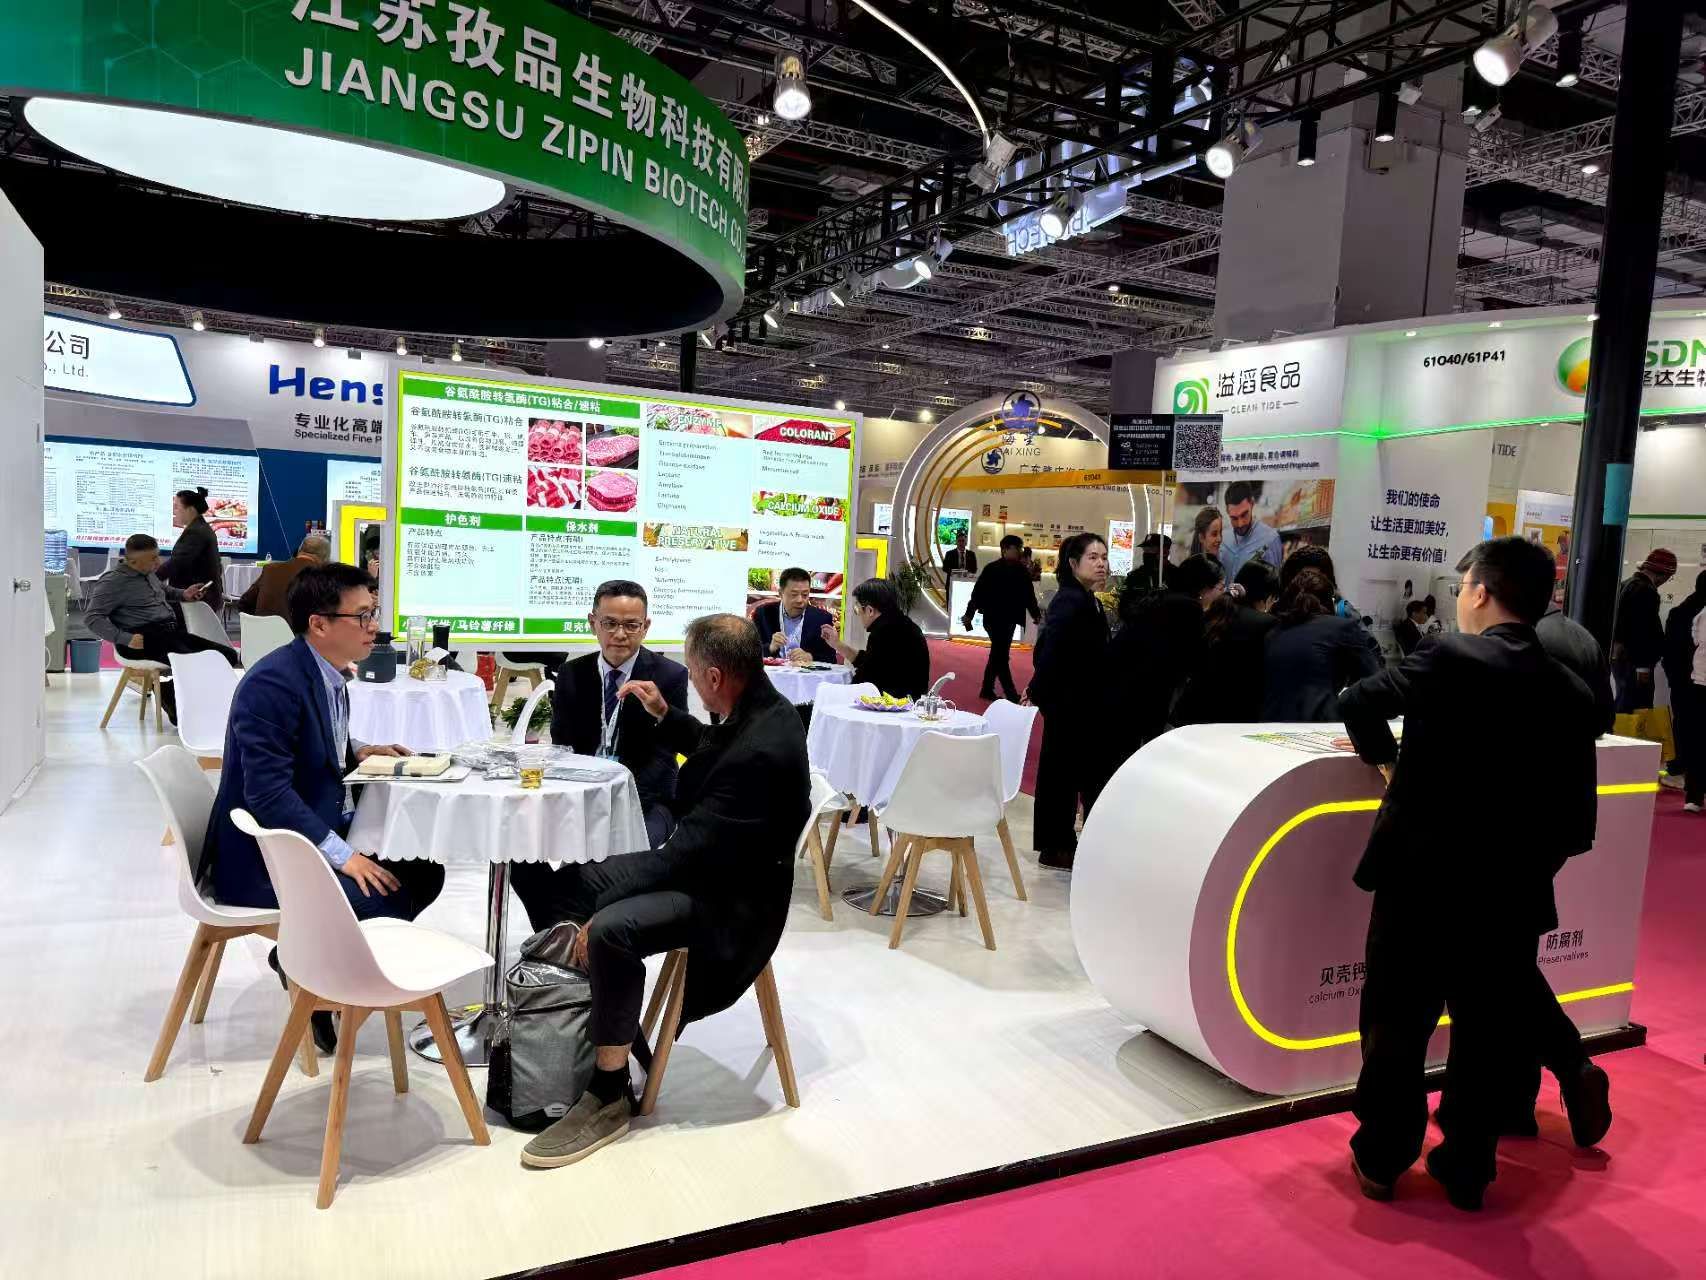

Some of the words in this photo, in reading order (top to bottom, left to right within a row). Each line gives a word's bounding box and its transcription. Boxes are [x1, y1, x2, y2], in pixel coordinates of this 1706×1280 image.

[284, 47, 524, 141] JIANGSU
[541, 115, 634, 183] ZIPIN
[645, 157, 728, 238] BIOTECH
[45, 330, 89, 360] 公司
[63, 363, 89, 378] Ltd.
[1216, 361, 1300, 399] 溢滔食品
[1230, 405, 1258, 414] CLEAN
[1261, 400, 1281, 411] TIDE
[294, 429, 350, 442] Specialized
[353, 433, 373, 443] Fine
[779, 426, 836, 441] COLORANT
[1016, 447, 1041, 456] XING
[1498, 444, 1517, 456] TIDE
[1386, 489, 1440, 508] 我们的使命
[767, 501, 808, 514] CALCIUM
[812, 505, 840, 517] OXIDE
[444, 513, 481, 526] 护色剂
[566, 520, 599, 533] 保水剂
[408, 527, 444, 537] 产品特点
[672, 525, 724, 538] NATURAL
[659, 536, 737, 549] PRESERVATIVE
[1546, 929, 1584, 951] 防腐剂
